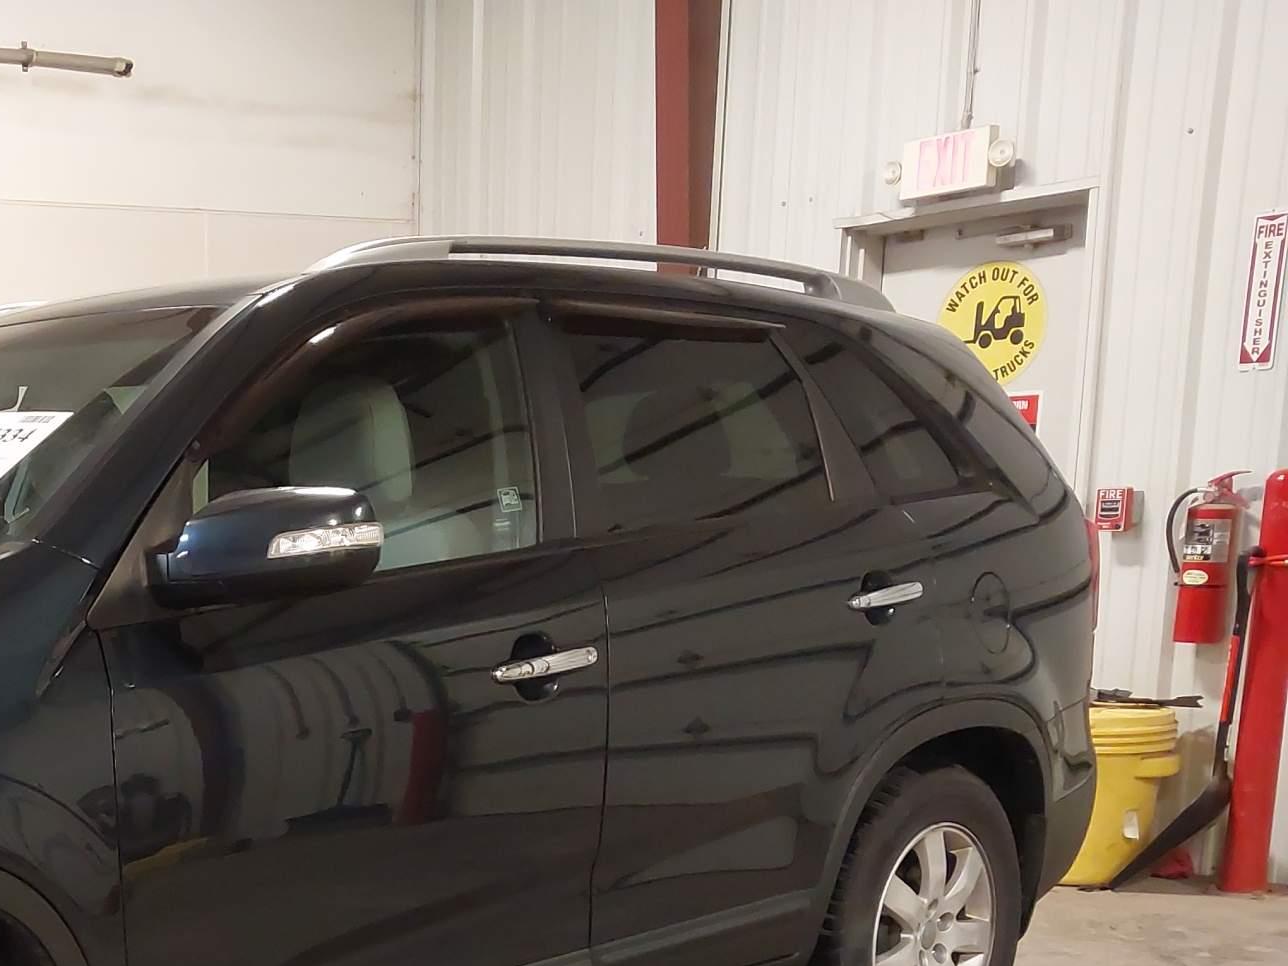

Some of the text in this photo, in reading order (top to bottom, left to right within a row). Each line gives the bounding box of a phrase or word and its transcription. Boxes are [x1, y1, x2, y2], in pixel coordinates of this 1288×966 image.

[916, 131, 976, 192] EXIT
[1257, 223, 1284, 239] FIRE
[946, 267, 1039, 313] WATCH OUT FOR
[1251, 241, 1274, 356] EXTINGUISHER
[993, 340, 1035, 380] TRUCKS
[1099, 490, 1123, 499] FIRE
